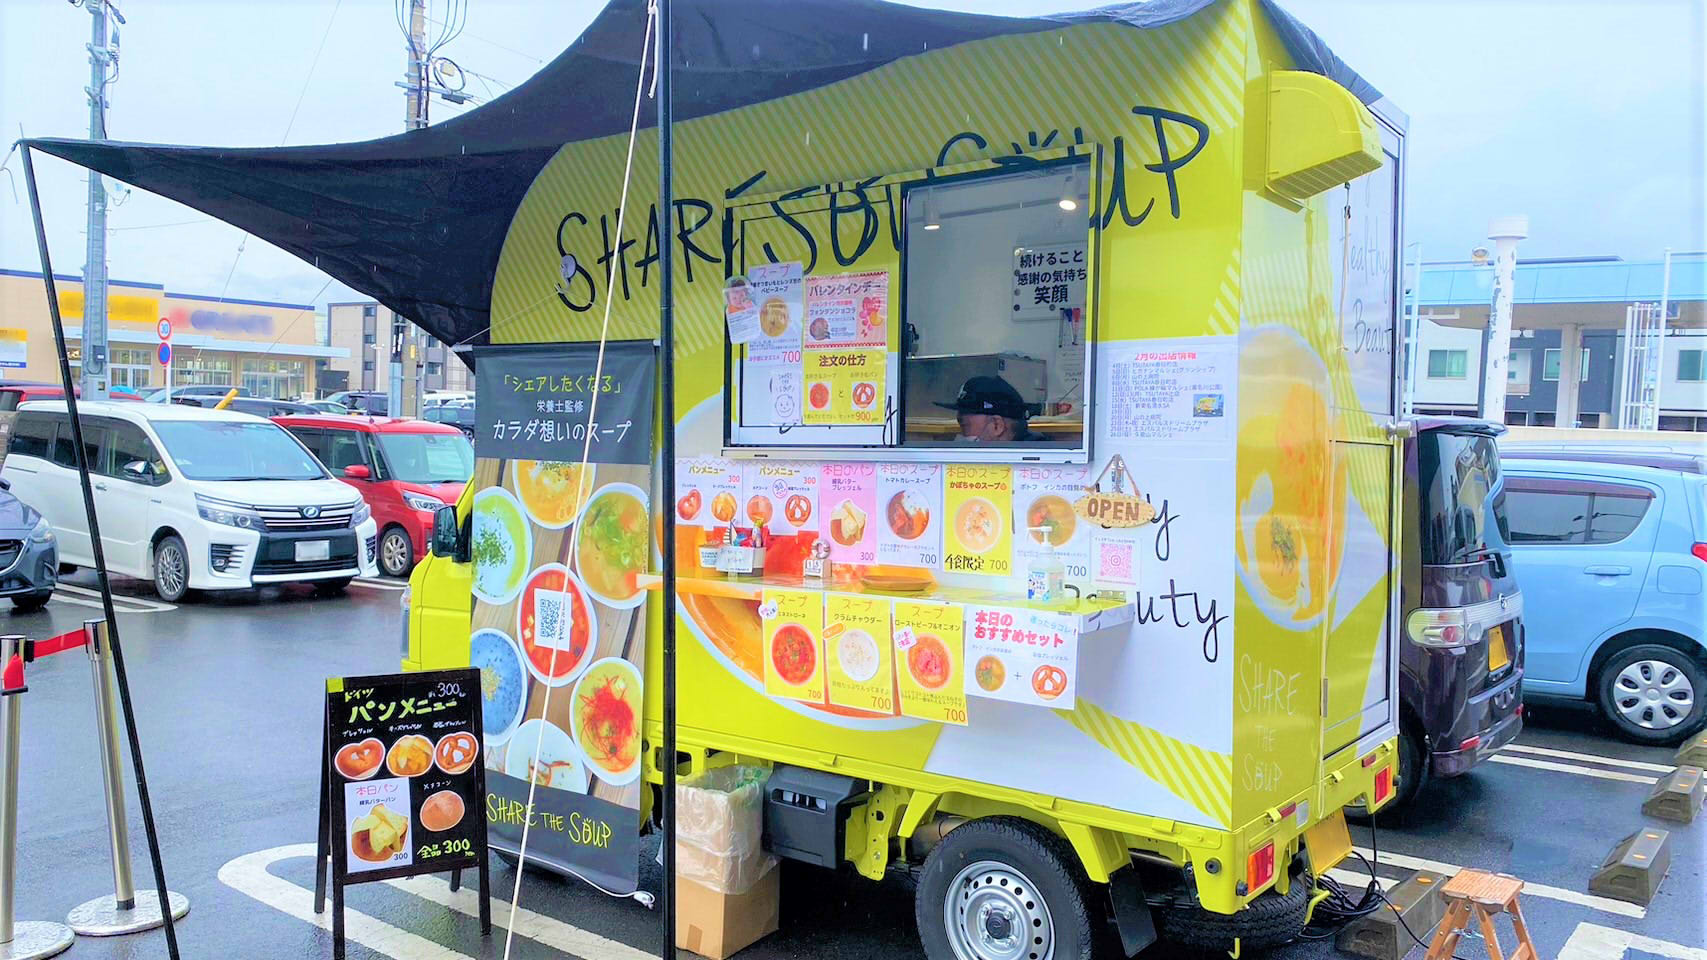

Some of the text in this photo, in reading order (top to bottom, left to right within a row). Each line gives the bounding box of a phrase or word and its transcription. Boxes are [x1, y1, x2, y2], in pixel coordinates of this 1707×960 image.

[1020, 249, 1083, 268] 続けること
[759, 264, 791, 278] スープ
[1017, 268, 1087, 285] 感謝の気持ち
[809, 280, 881, 297] バレンタインデー
[1034, 284, 1068, 304] 笑顔
[782, 351, 800, 363] 700
[819, 354, 867, 367] 注文の仕方
[504, 374, 622, 394] 「シェアしたくなる」
[536, 399, 584, 413] 栄養士監修
[856, 411, 871, 422] 900
[493, 420, 632, 443] カラダ想いのスープ
[689, 465, 726, 474] パンメニュー
[759, 465, 801, 476] パンメニュー
[822, 464, 874, 476] 本日のパン
[880, 463, 939, 476] 本日のスープ
[946, 466, 1012, 480] 本日のスープ
[1018, 467, 1088, 481] 本日のスープ
[728, 475, 741, 483] 300
[803, 476, 817, 485] 300
[885, 477, 931, 485] トマトカレースープ
[950, 481, 1001, 490] かぼちゃのスープ
[1087, 497, 1140, 521] OPEN
[860, 552, 874, 561] 300
[919, 553, 937, 565] 700
[990, 559, 1008, 571] 700
[1067, 565, 1087, 577] 700
[777, 595, 808, 608] スープ
[843, 598, 873, 611] スープ
[834, 613, 883, 624] クラムチャウダー
[912, 606, 944, 619] スープ
[975, 610, 1013, 627] 本日の
[975, 625, 1064, 648] おすすめセット
[438, 682, 461, 698] 300
[1239, 653, 1302, 716] SHARE
[344, 688, 374, 703] ドイツ
[808, 689, 822, 699] 700
[348, 697, 458, 723] パンメニュー
[871, 696, 891, 711] 700
[944, 708, 966, 723] 700
[1255, 724, 1277, 752] THE
[486, 793, 537, 827] SHARE
[540, 812, 564, 833] THE
[417, 838, 471, 859] 全品 300
[394, 853, 409, 861] 300
